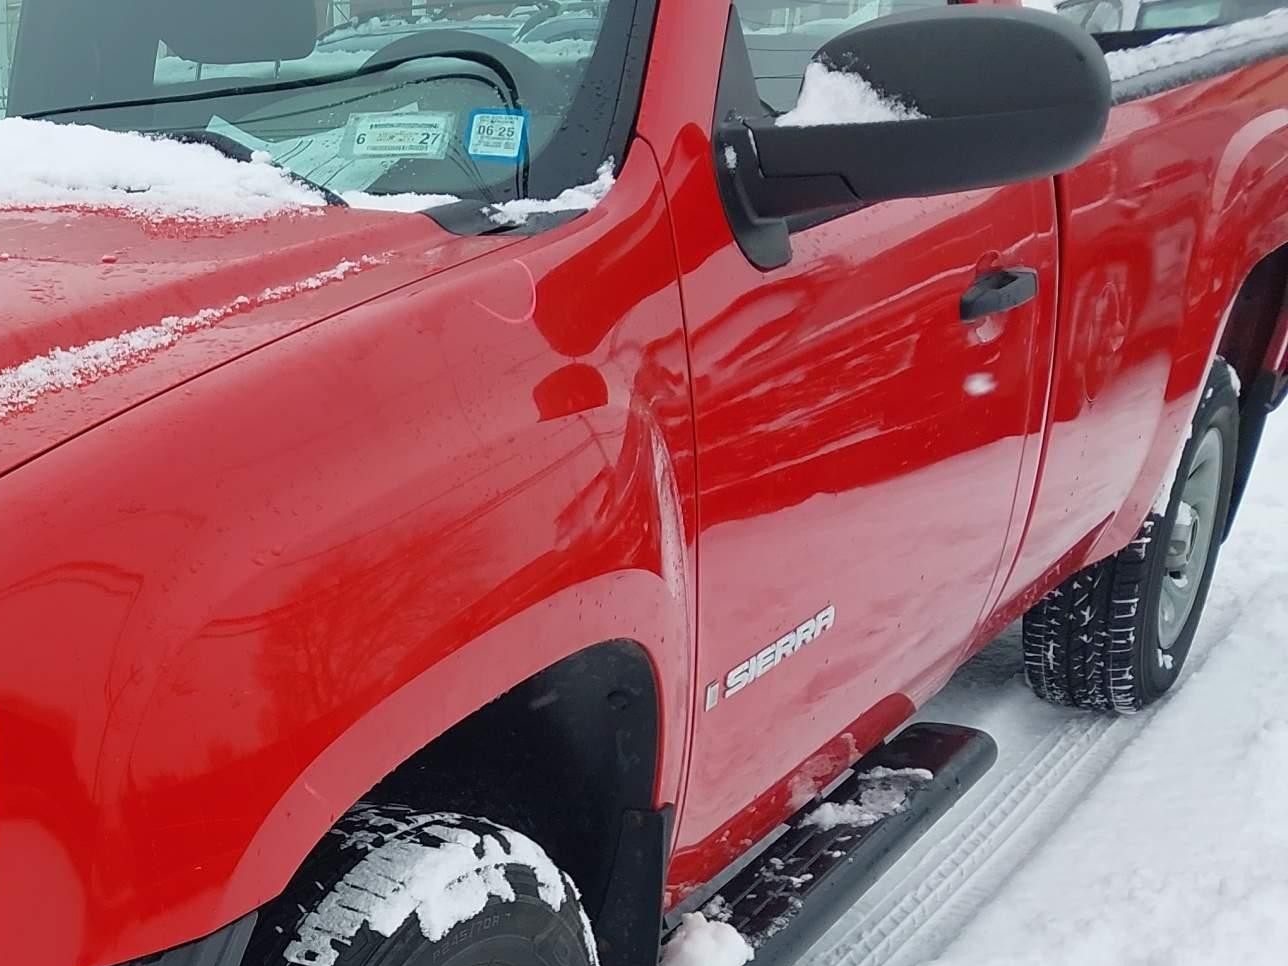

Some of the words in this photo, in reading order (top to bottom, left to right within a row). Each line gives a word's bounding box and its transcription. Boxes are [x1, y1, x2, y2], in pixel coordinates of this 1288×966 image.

[356, 132, 367, 145] 6
[418, 132, 440, 145] 27
[724, 604, 835, 699] SIERRA
